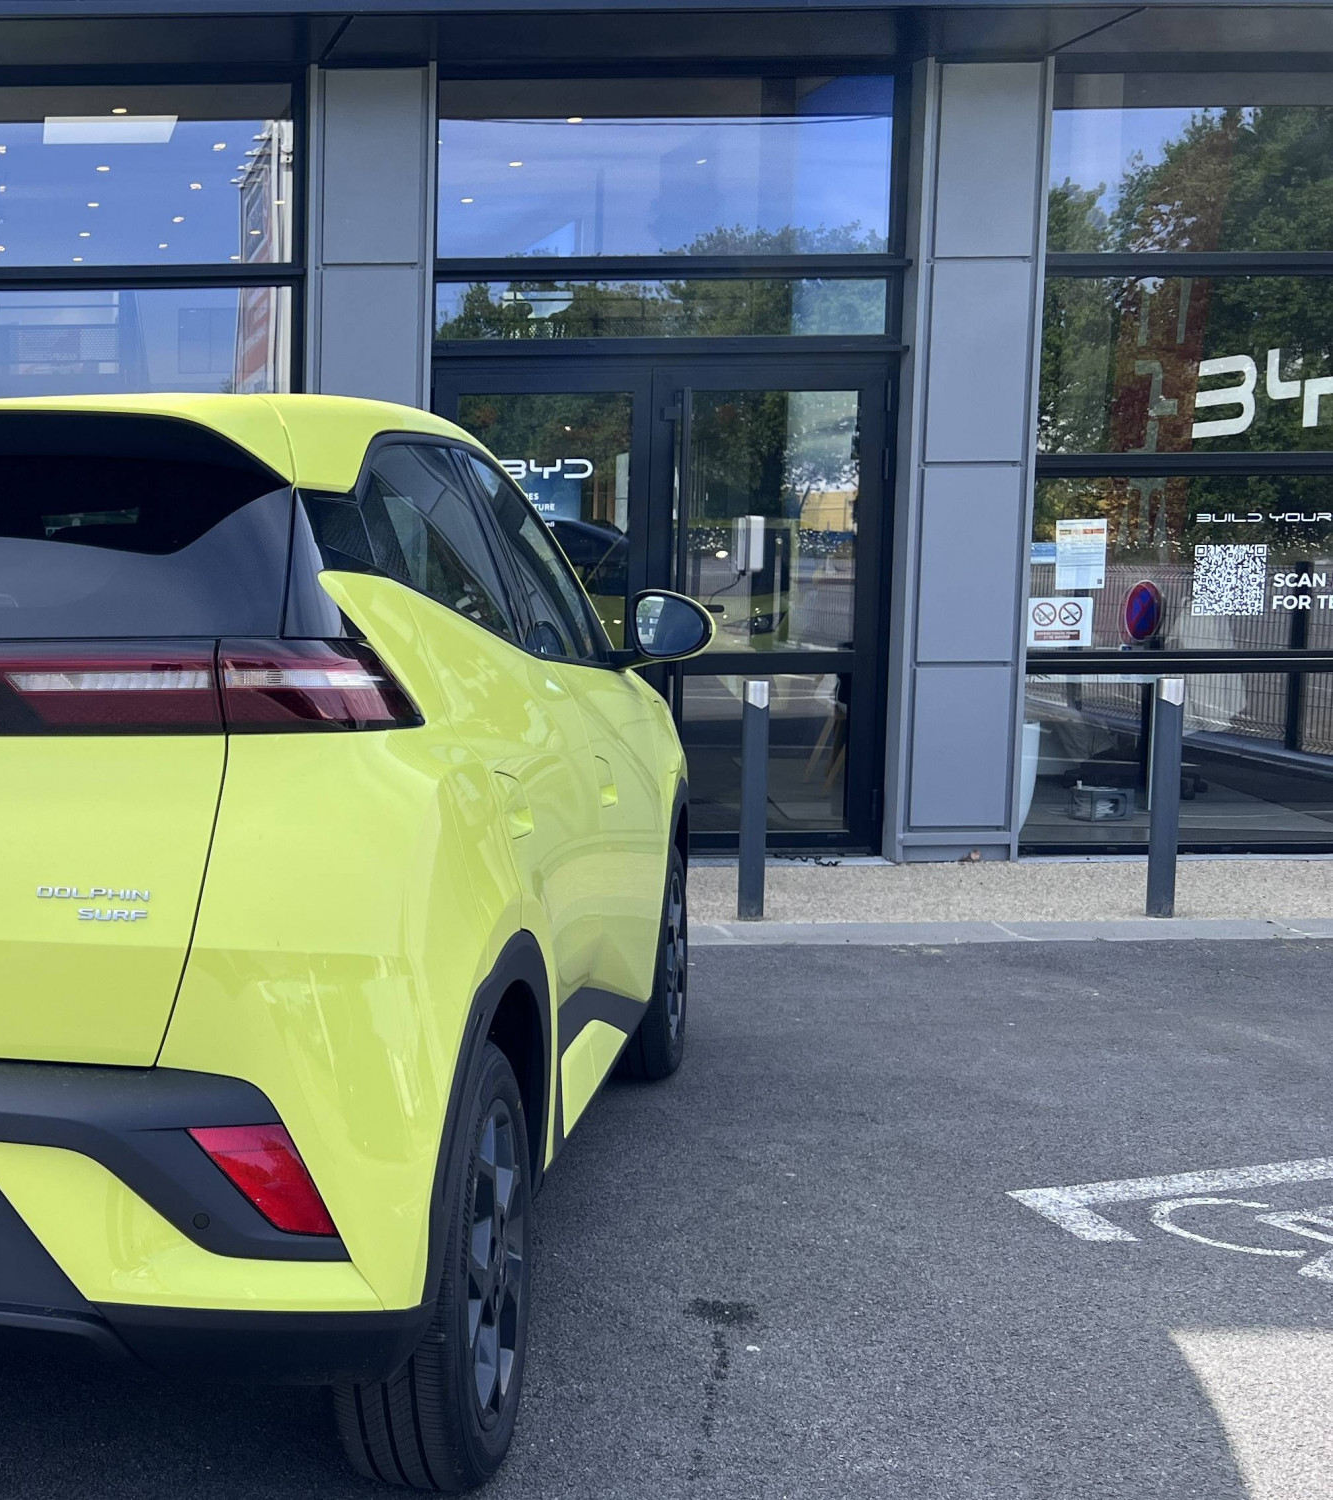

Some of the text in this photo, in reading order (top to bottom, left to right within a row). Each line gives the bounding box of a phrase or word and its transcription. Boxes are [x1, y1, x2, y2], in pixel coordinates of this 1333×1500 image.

[498, 458, 594, 479] BYD
[1196, 512, 1332, 523] BUILD YOUR
[1272, 572, 1327, 588] SCAN
[1272, 594, 1312, 610] FOR
[35, 886, 150, 902] DOLPHIN
[77, 908, 149, 922] SURF
